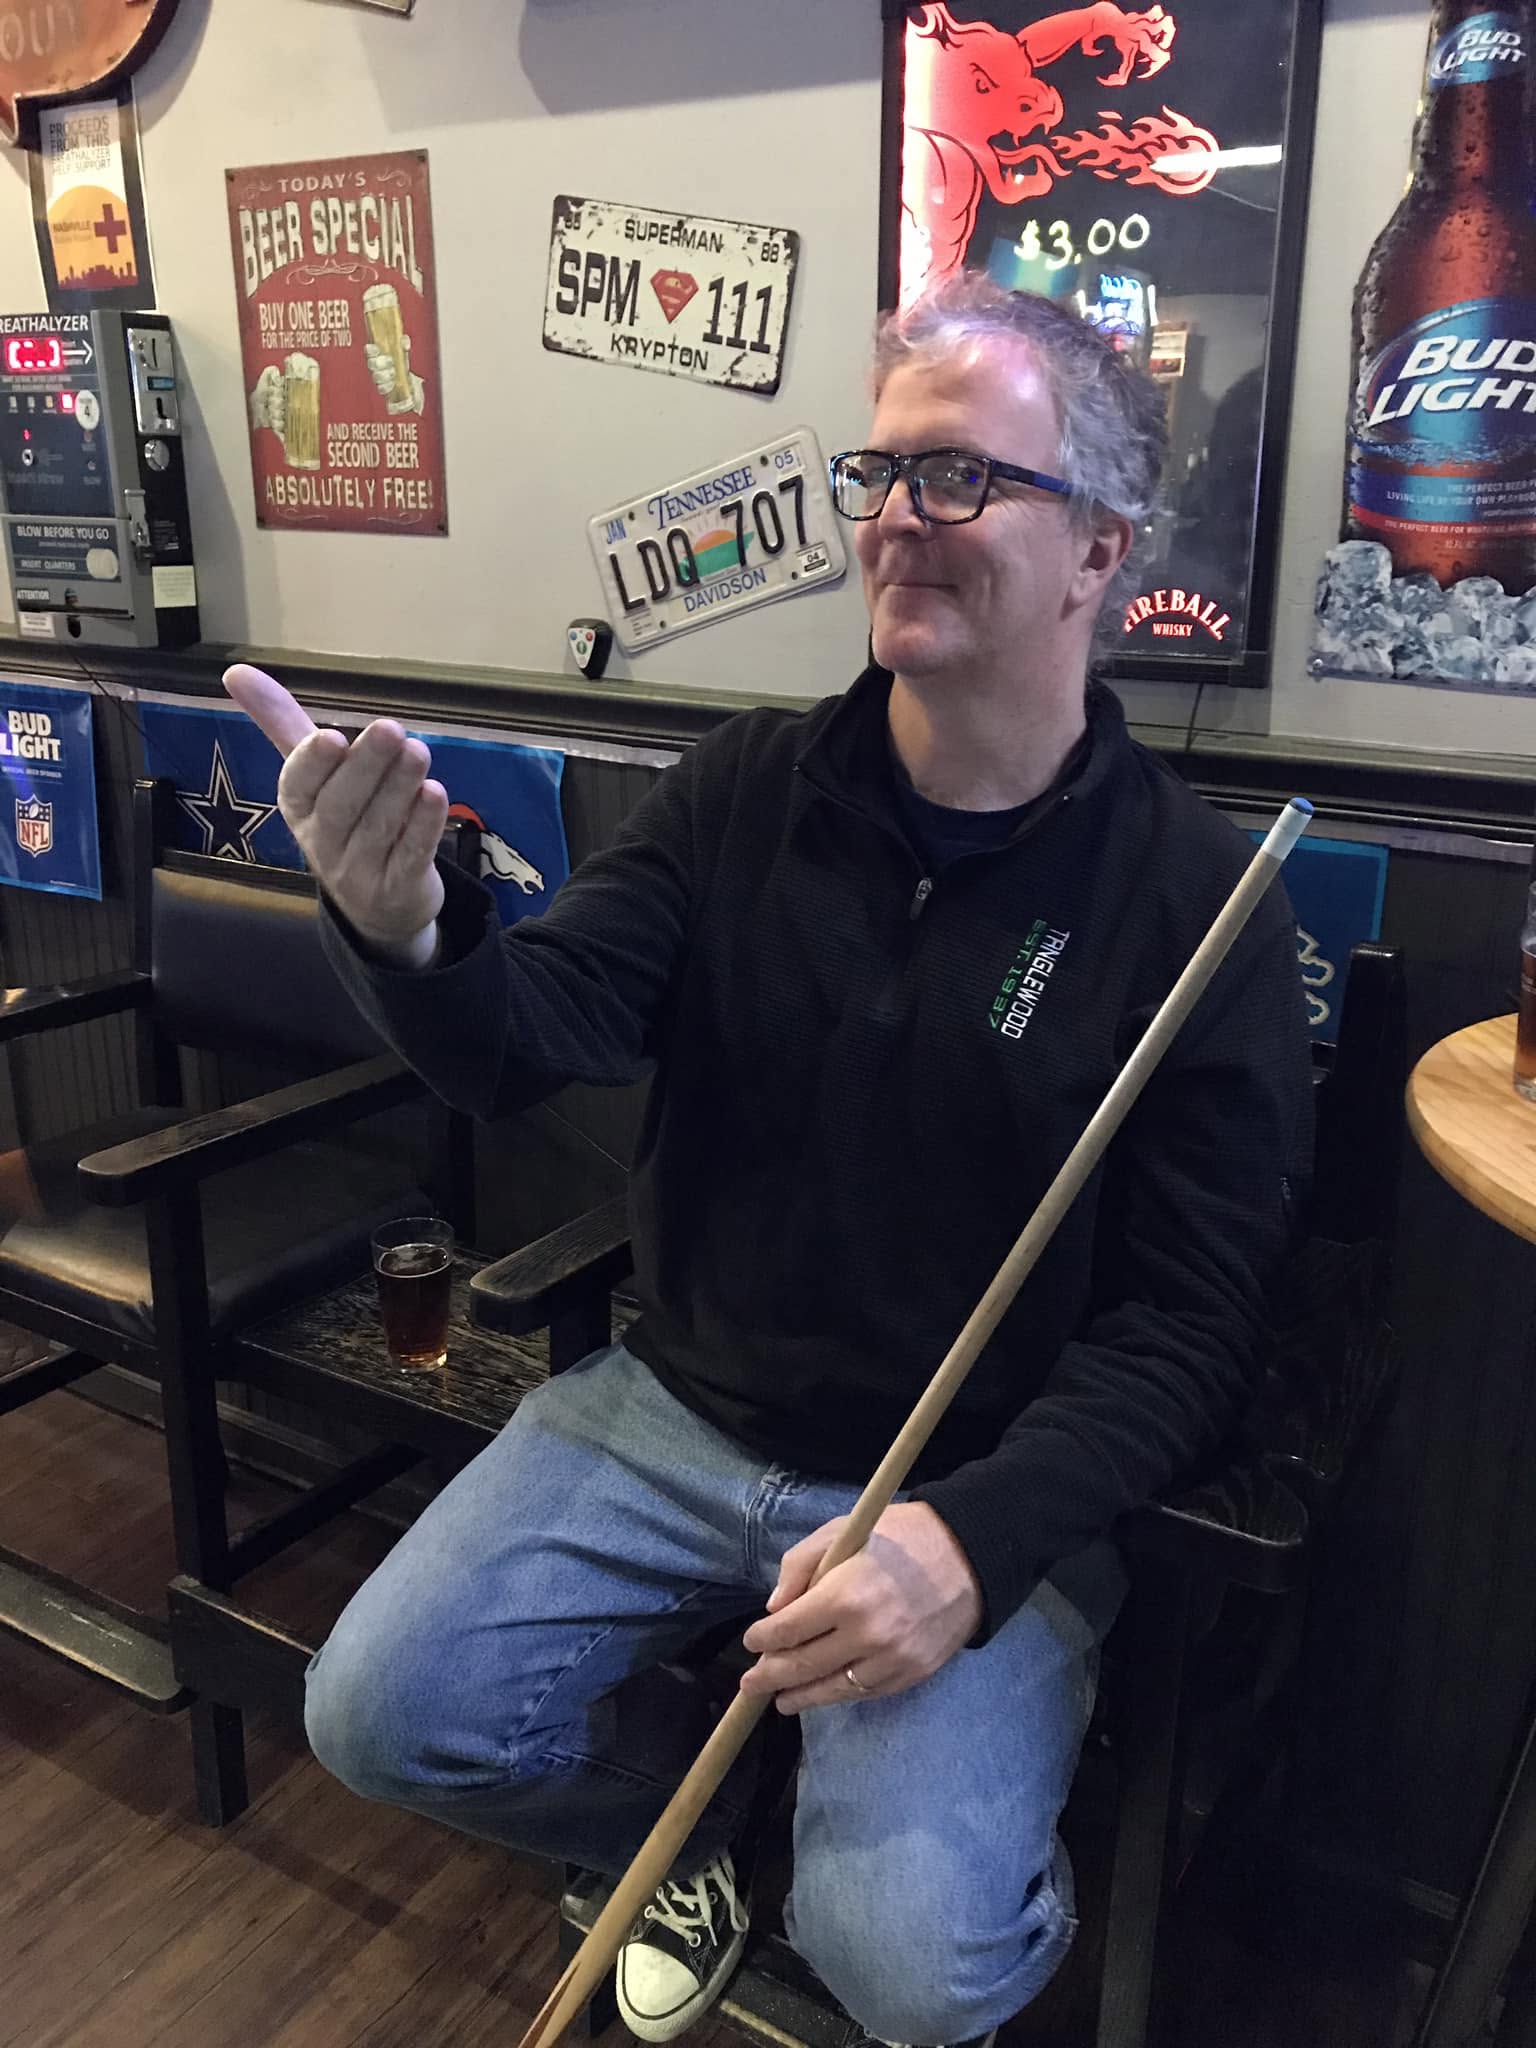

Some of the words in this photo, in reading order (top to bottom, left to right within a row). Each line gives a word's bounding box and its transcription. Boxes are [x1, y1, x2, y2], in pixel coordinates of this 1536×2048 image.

[1457, 28, 1522, 50] BUD
[1440, 47, 1527, 73] LIGHT
[49, 116, 110, 137] PROCEEDS
[50, 136, 80, 153] FROM
[85, 133, 111, 148] THIS
[278, 171, 367, 193] TODAY'S
[239, 200, 305, 300] BEER
[310, 192, 425, 298] SPECIAL
[624, 218, 723, 254] SUPERMAN
[1013, 213, 1151, 272] $3.00
[761, 242, 780, 263] 88
[556, 247, 641, 326] SPM
[702, 276, 773, 354] 111
[259, 302, 284, 331] BUY
[288, 301, 315, 330] ONE
[318, 300, 351, 329] BEER
[262, 332, 279, 349] FOR
[279, 332, 296, 349] THE
[296, 331, 320, 348] PRICE
[321, 331, 333, 347] OF
[334, 330, 352, 347] TWO
[610, 333, 709, 371] KRYPTON
[1397, 334, 1536, 381] BUD
[327, 423, 349, 440] AND
[352, 423, 395, 440] RECEIVE
[397, 423, 418, 440] THE
[328, 442, 381, 468] SECOND
[386, 443, 419, 469] BEER
[774, 450, 795, 469] 05
[266, 473, 376, 509] ABSOLUTELY
[17, 525, 43, 537] BLOW
[44, 526, 76, 538] BEFORE
[76, 527, 95, 540] YOU
[95, 528, 110, 540] GO
[605, 518, 627, 545] JAN
[608, 527, 701, 611] LDQ
[719, 474, 807, 567] 707
[20, 559, 42, 569] INSERT
[44, 560, 76, 570] QUARTERS
[806, 551, 821, 563] 04
[683, 567, 767, 612] DAVIDSON
[1152, 623, 1193, 637] WHISKY
[8, 710, 52, 736] BUD
[0, 733, 62, 761] LIGHT
[20, 820, 49, 847] NFL
[1001, 928, 1071, 1039] TANGLEWOOD
